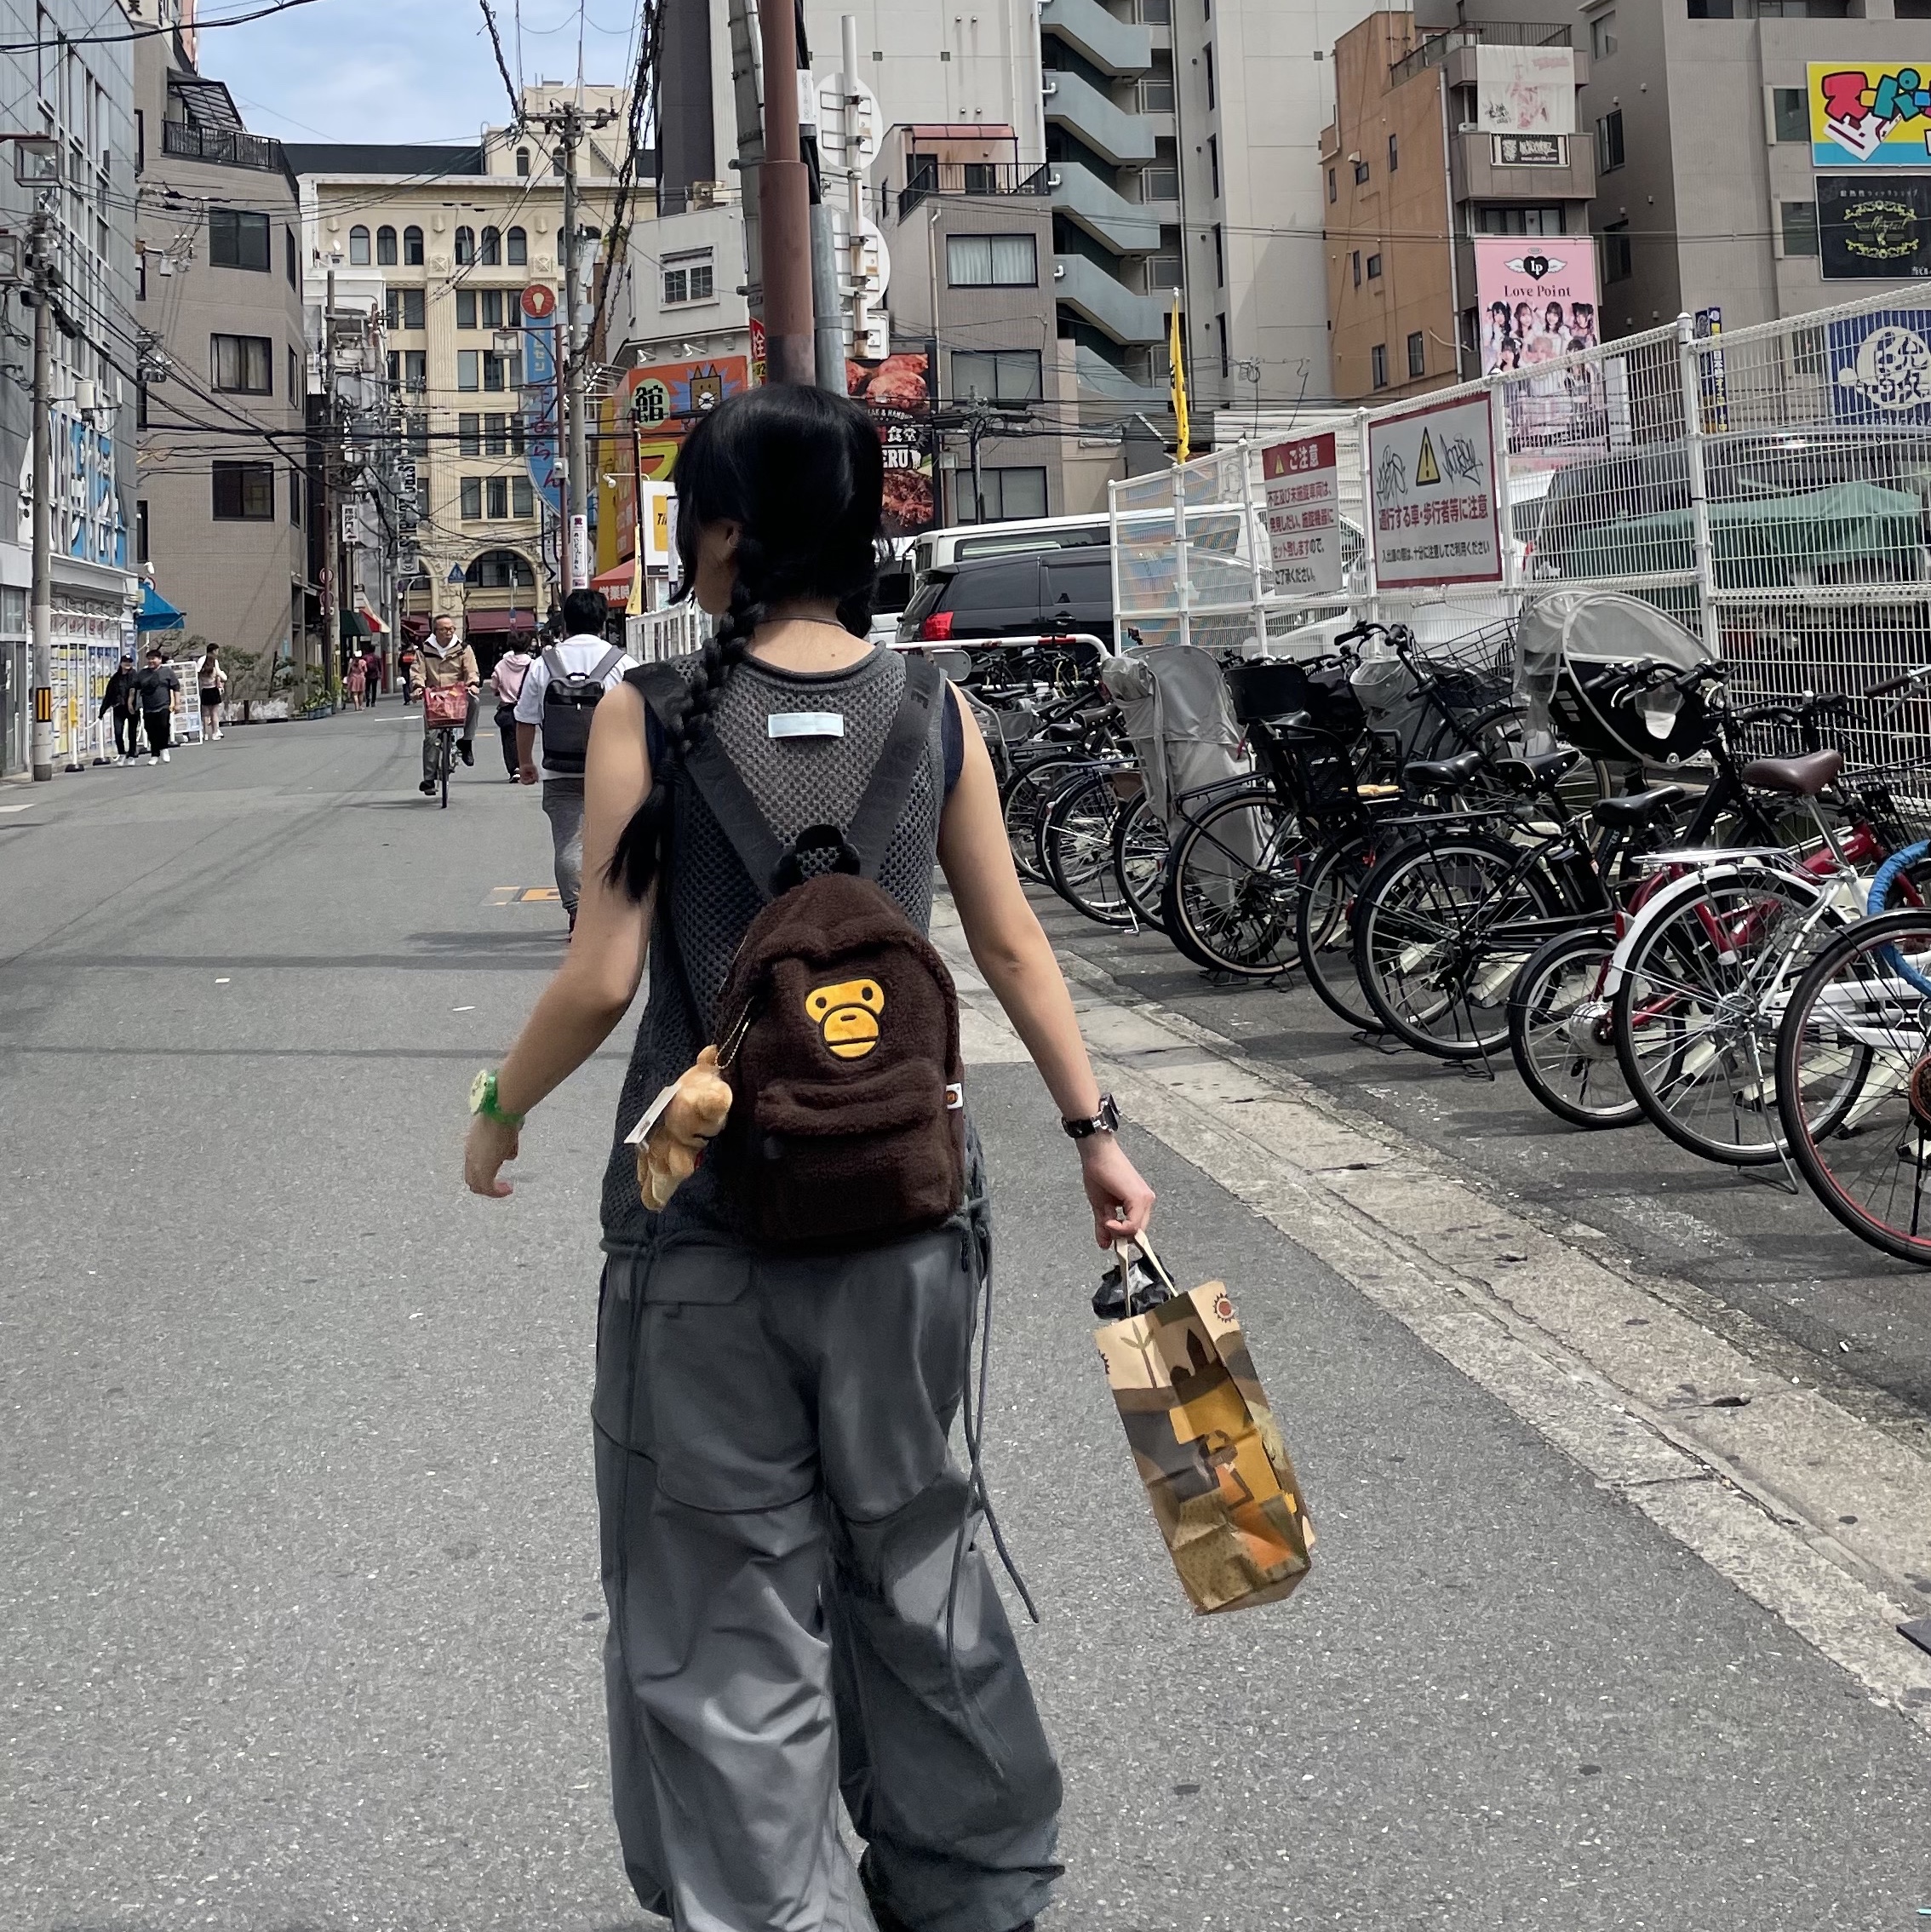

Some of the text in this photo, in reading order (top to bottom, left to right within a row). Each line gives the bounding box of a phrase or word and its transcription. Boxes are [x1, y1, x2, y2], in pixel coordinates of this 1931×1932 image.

[1821, 67, 1931, 123] スーパー
[1504, 284, 1571, 297] Love Point
[635, 384, 664, 423] 館
[1289, 443, 1320, 471] ご注意
